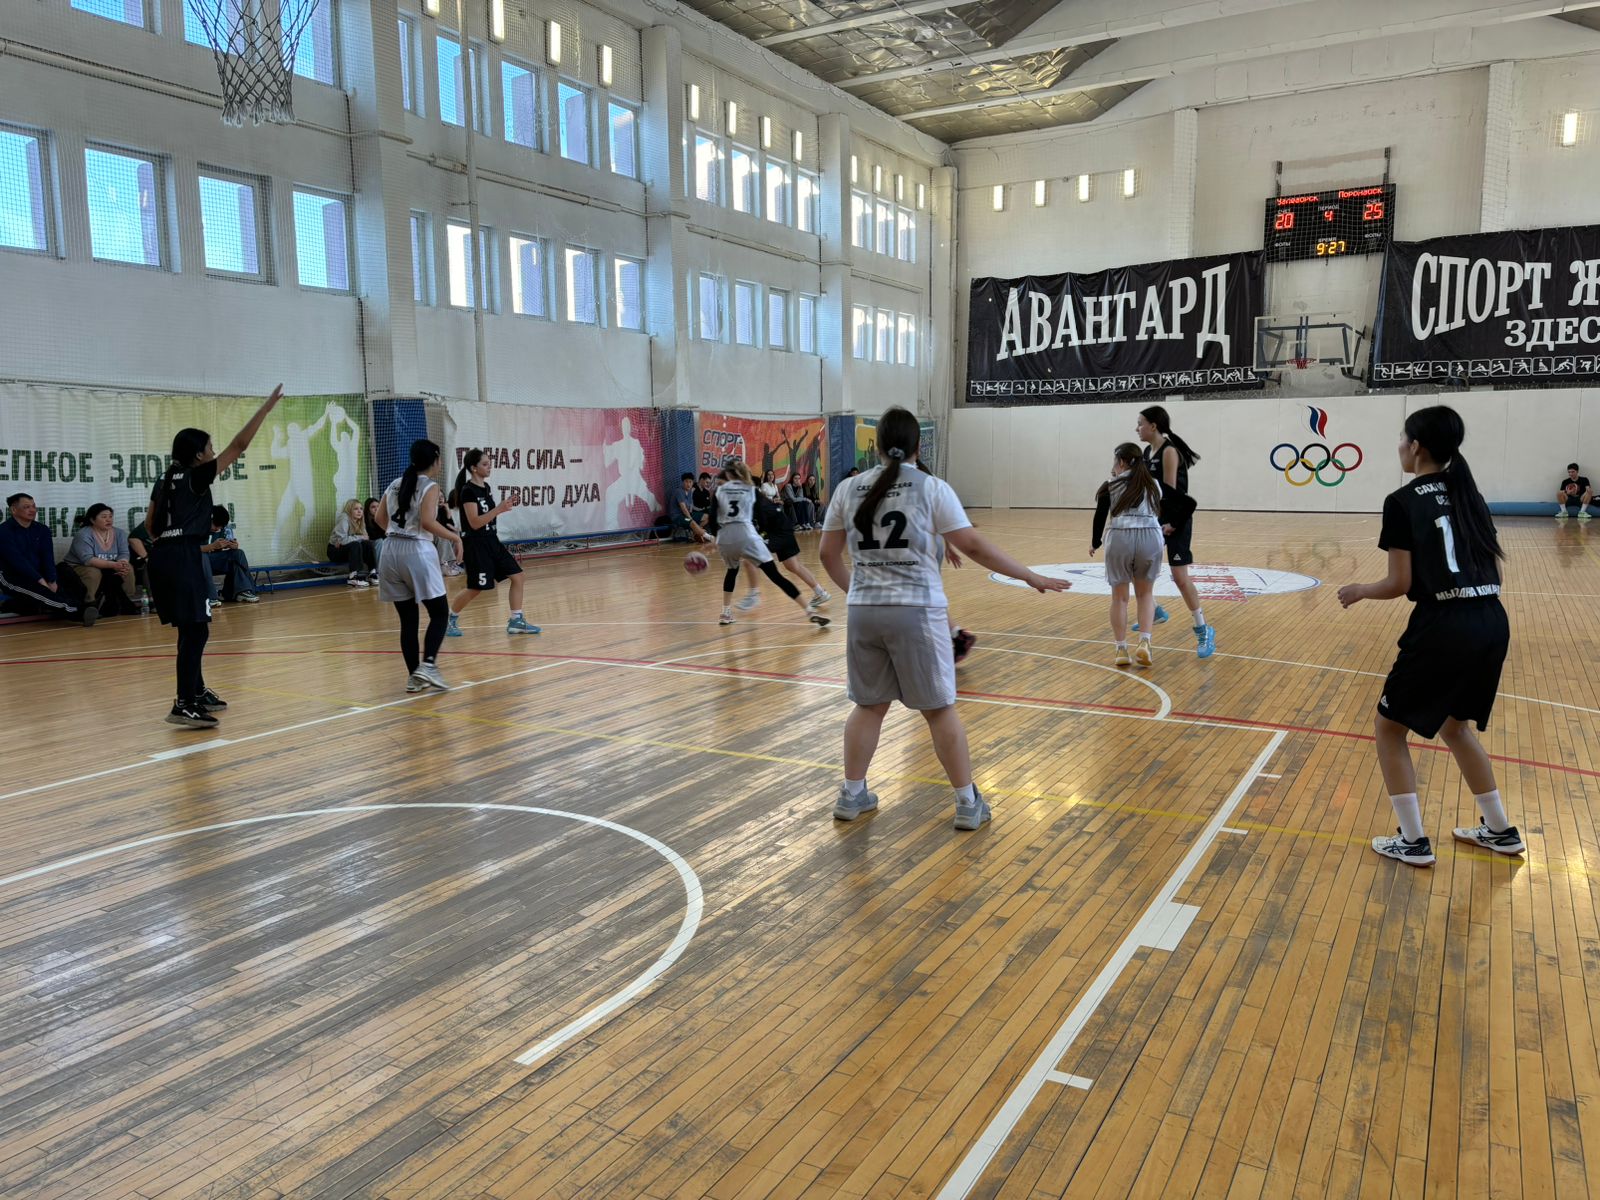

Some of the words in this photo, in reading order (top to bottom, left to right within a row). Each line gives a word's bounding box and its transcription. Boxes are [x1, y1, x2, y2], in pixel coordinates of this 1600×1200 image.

[1275, 212, 1294, 230] 20
[1324, 210, 1333, 221] 4
[1364, 203, 1383, 220] 25
[1317, 241, 1345, 255] 9:27
[1411, 252, 1552, 341] СПОРТ
[996, 262, 1231, 365] АВАНГАРД
[1504, 316, 1600, 352] ЗДЕС
[526, 449, 566, 470] СИЛА
[561, 482, 601, 508] ДУХА
[480, 500, 489, 513] 5
[727, 500, 741, 518] 3
[857, 510, 909, 551] 12
[1434, 515, 1461, 573] 1
[478, 573, 487, 586] 5
